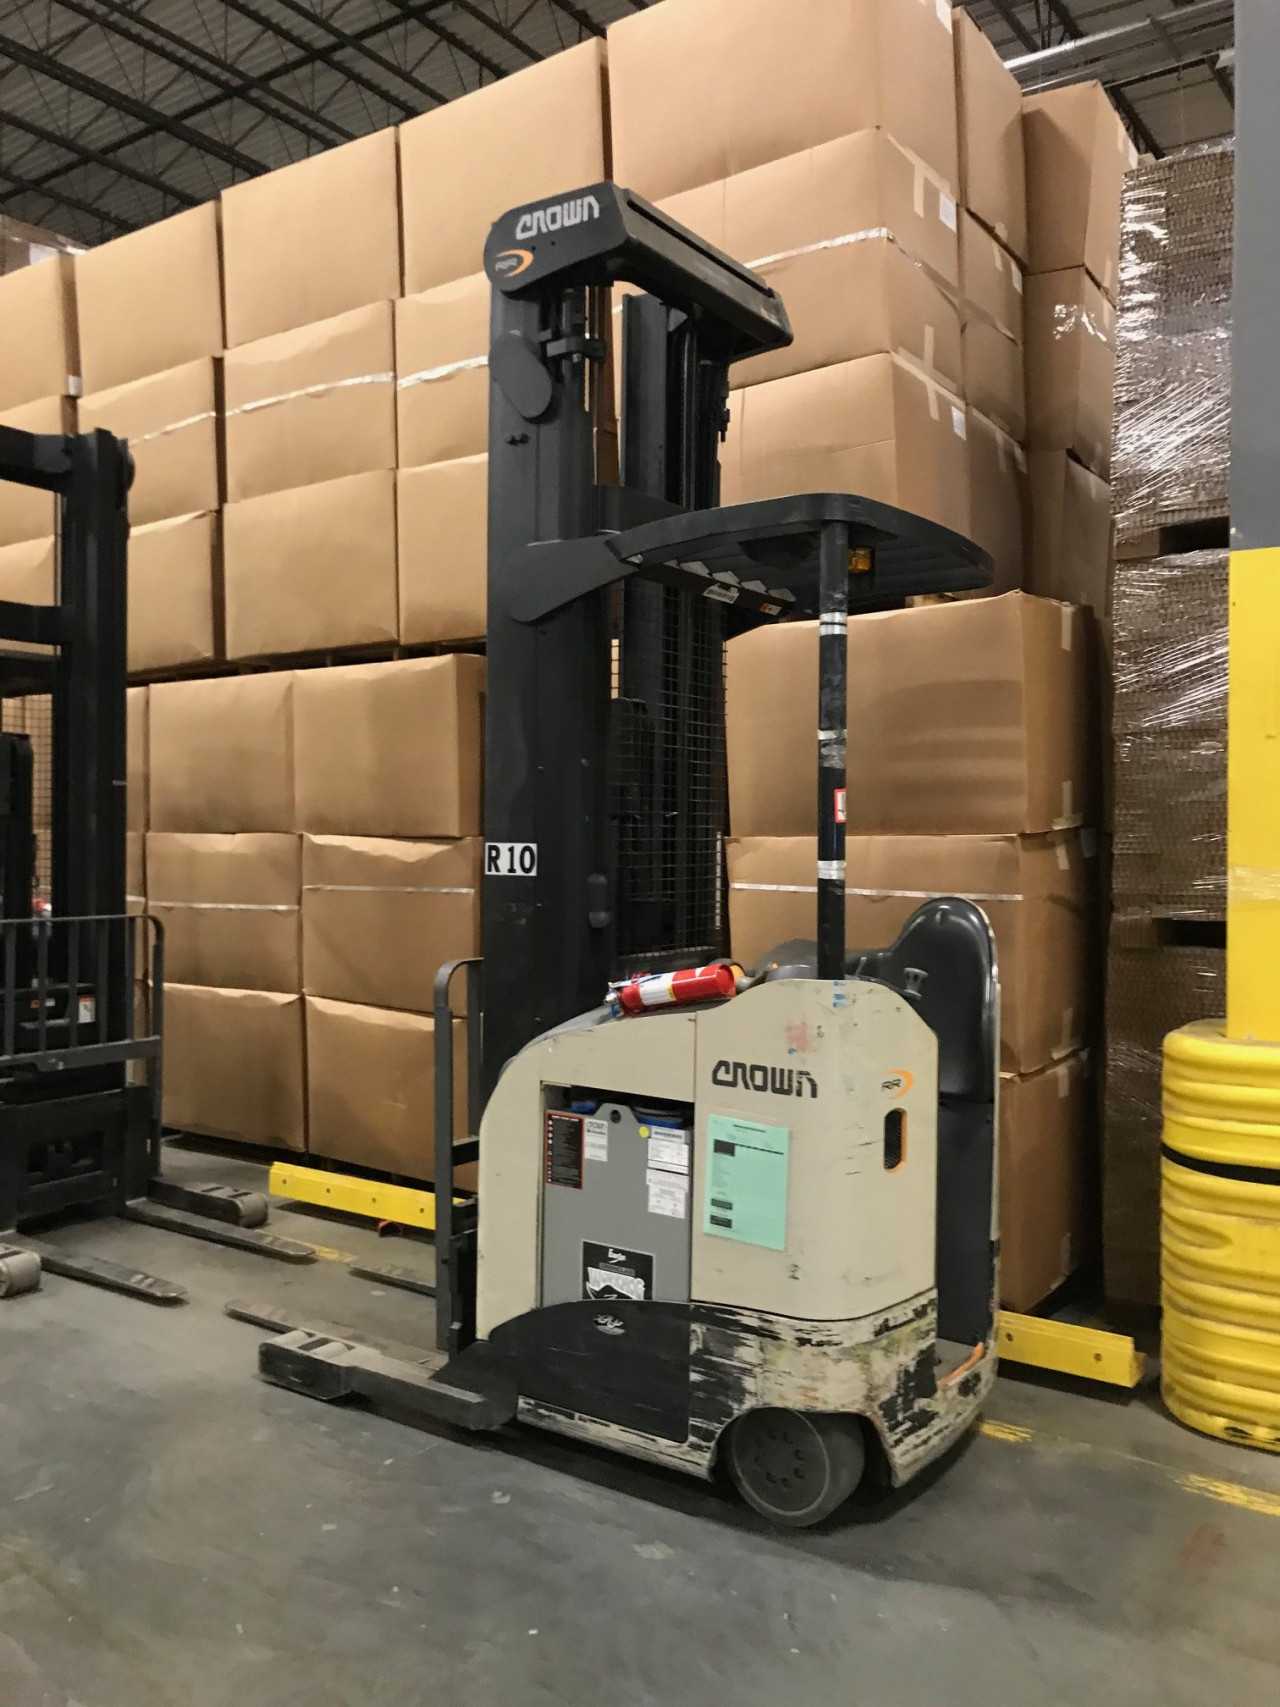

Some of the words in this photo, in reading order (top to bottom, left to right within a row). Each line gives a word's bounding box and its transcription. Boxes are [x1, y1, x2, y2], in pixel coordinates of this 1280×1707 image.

[515, 194, 600, 241] CROWN
[487, 844, 536, 874] R10
[712, 1059, 818, 1099] CROWN
